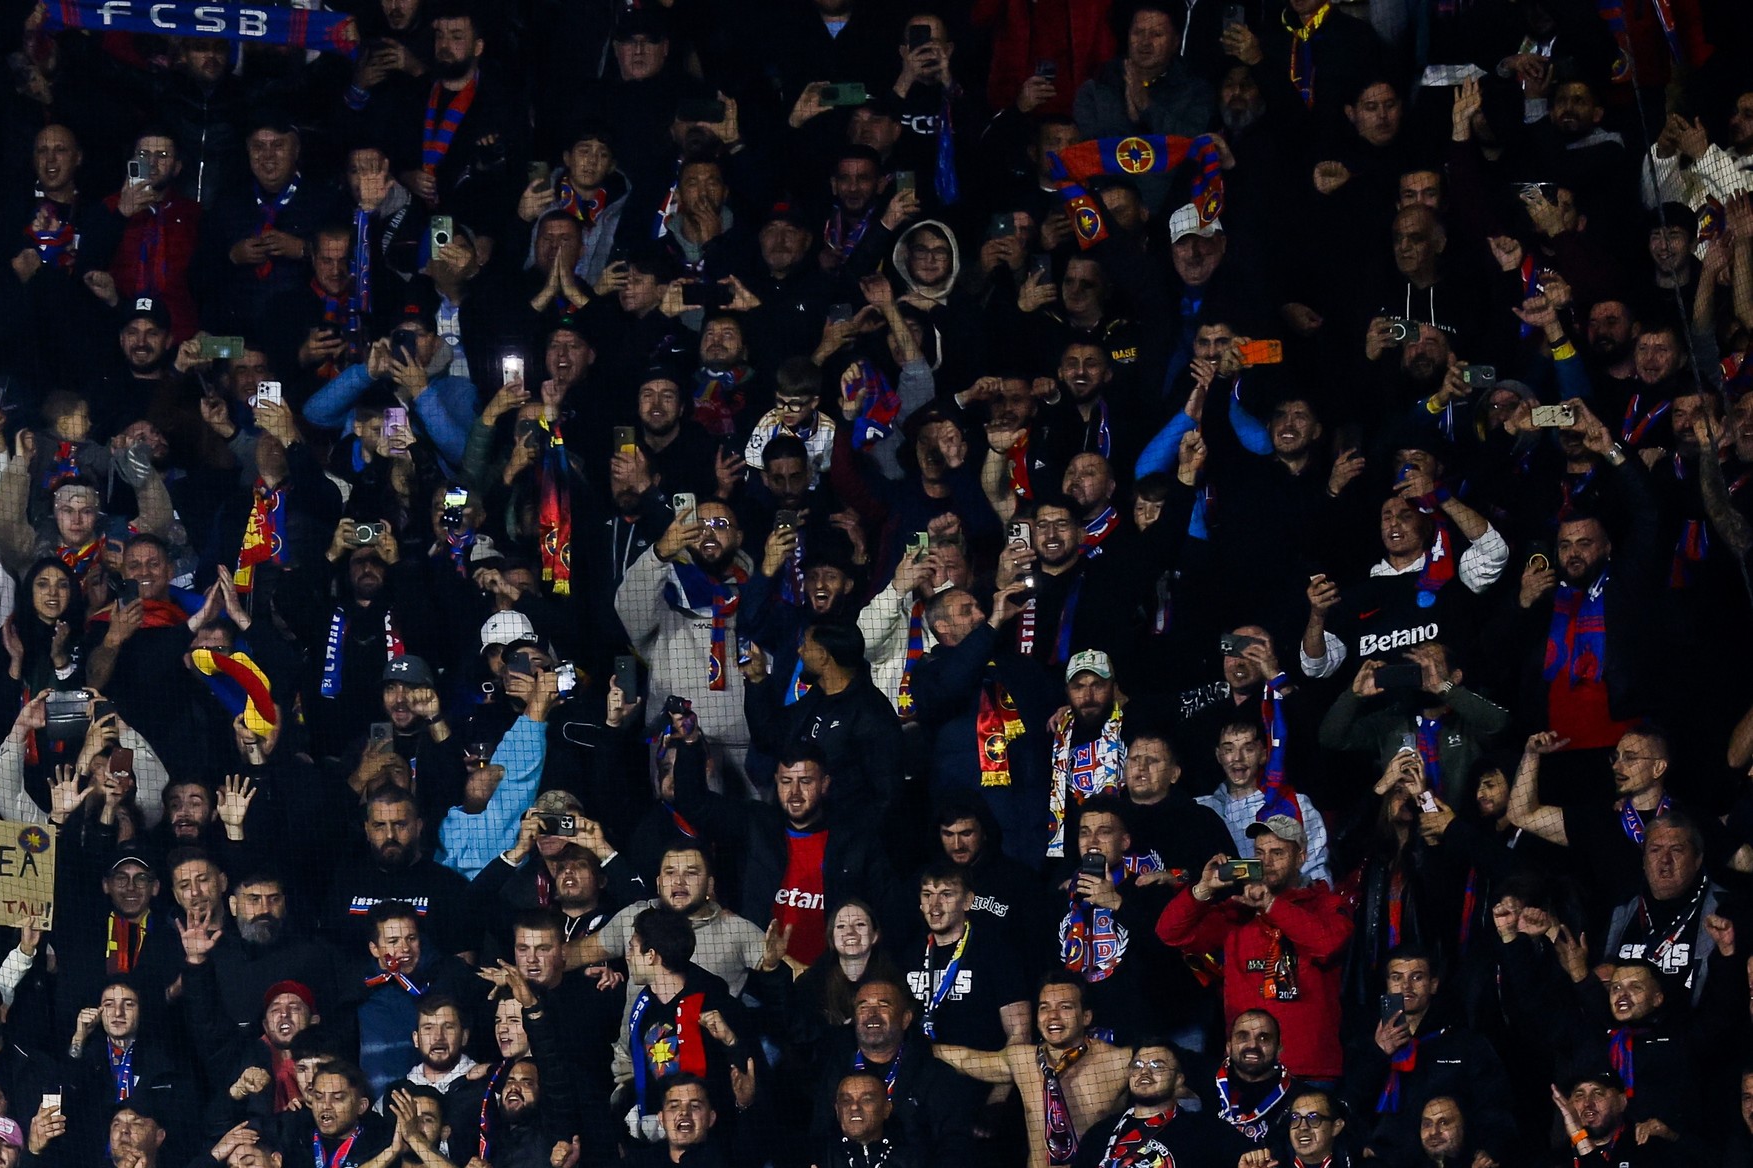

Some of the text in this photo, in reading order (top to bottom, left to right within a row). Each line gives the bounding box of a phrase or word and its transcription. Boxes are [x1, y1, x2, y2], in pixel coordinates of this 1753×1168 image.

[96, 1, 268, 37] FCSB
[1359, 622, 1439, 656] Betano
[774, 886, 825, 911] etan
